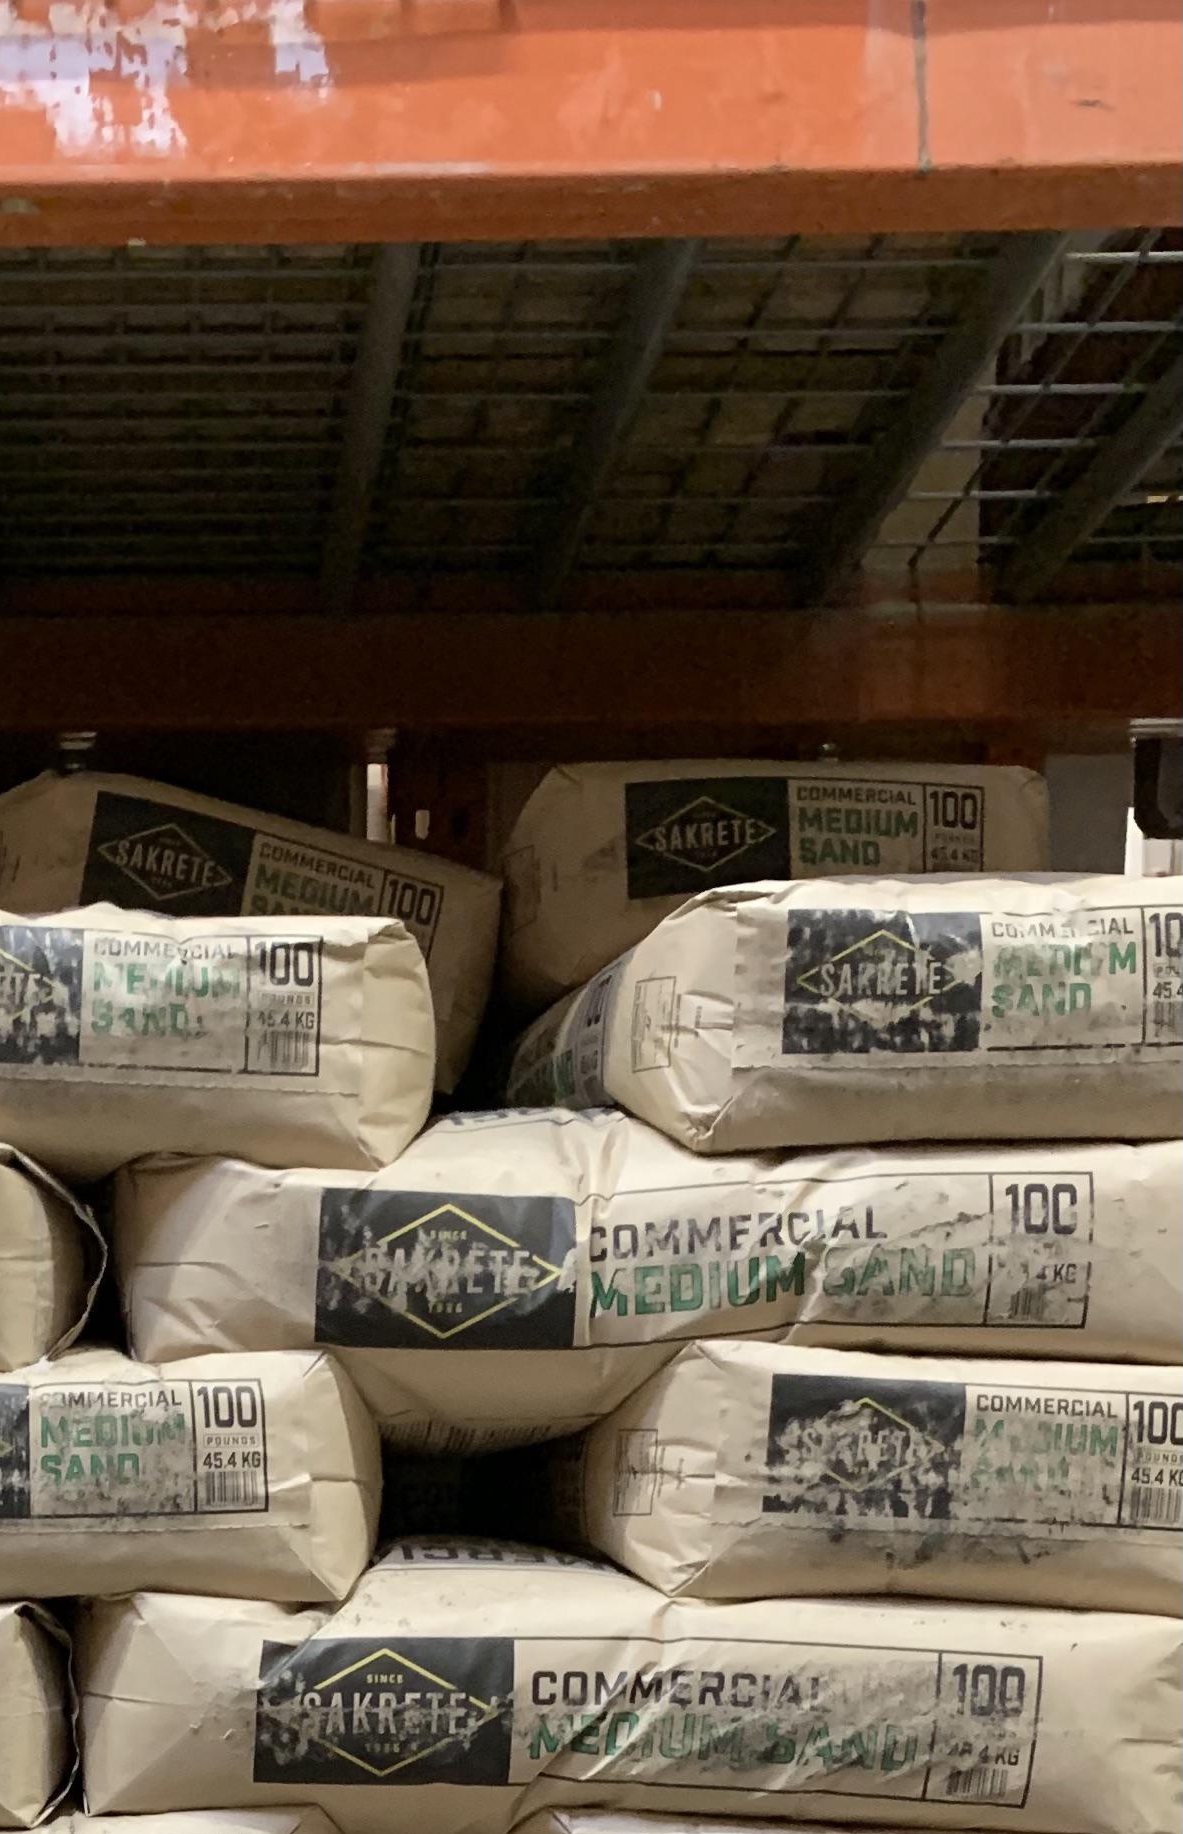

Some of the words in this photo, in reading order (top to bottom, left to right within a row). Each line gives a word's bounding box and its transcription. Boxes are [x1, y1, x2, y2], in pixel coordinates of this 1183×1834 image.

[797, 786, 917, 806] COMMERCIAL
[929, 790, 978, 830] 100
[654, 819, 758, 853] SAKRETE
[798, 807, 918, 839] MEDIUM
[119, 839, 216, 887] SAKRETE
[259, 841, 376, 889] COMMERCIAL
[799, 838, 881, 867] SAND
[389, 878, 436, 926] 100
[258, 943, 315, 988] 100
[295, 1011, 315, 1030] KG
[589, 1205, 889, 1263] COMMERCIAL
[589, 1250, 807, 1320] MEDIUM
[197, 1385, 257, 1429] 100
[976, 1394, 1118, 1418] COMMERCIAL
[206, 1436, 256, 1446] POUNDS
[40, 1453, 140, 1487] SAND
[203, 1452, 237, 1469] 45.4
[242, 1450, 261, 1468] KG
[1131, 1467, 1163, 1486] 45.4
[366, 1674, 404, 1684] SINCE
[952, 1663, 1025, 1718] 100
[765, 1722, 916, 1771] SAND
